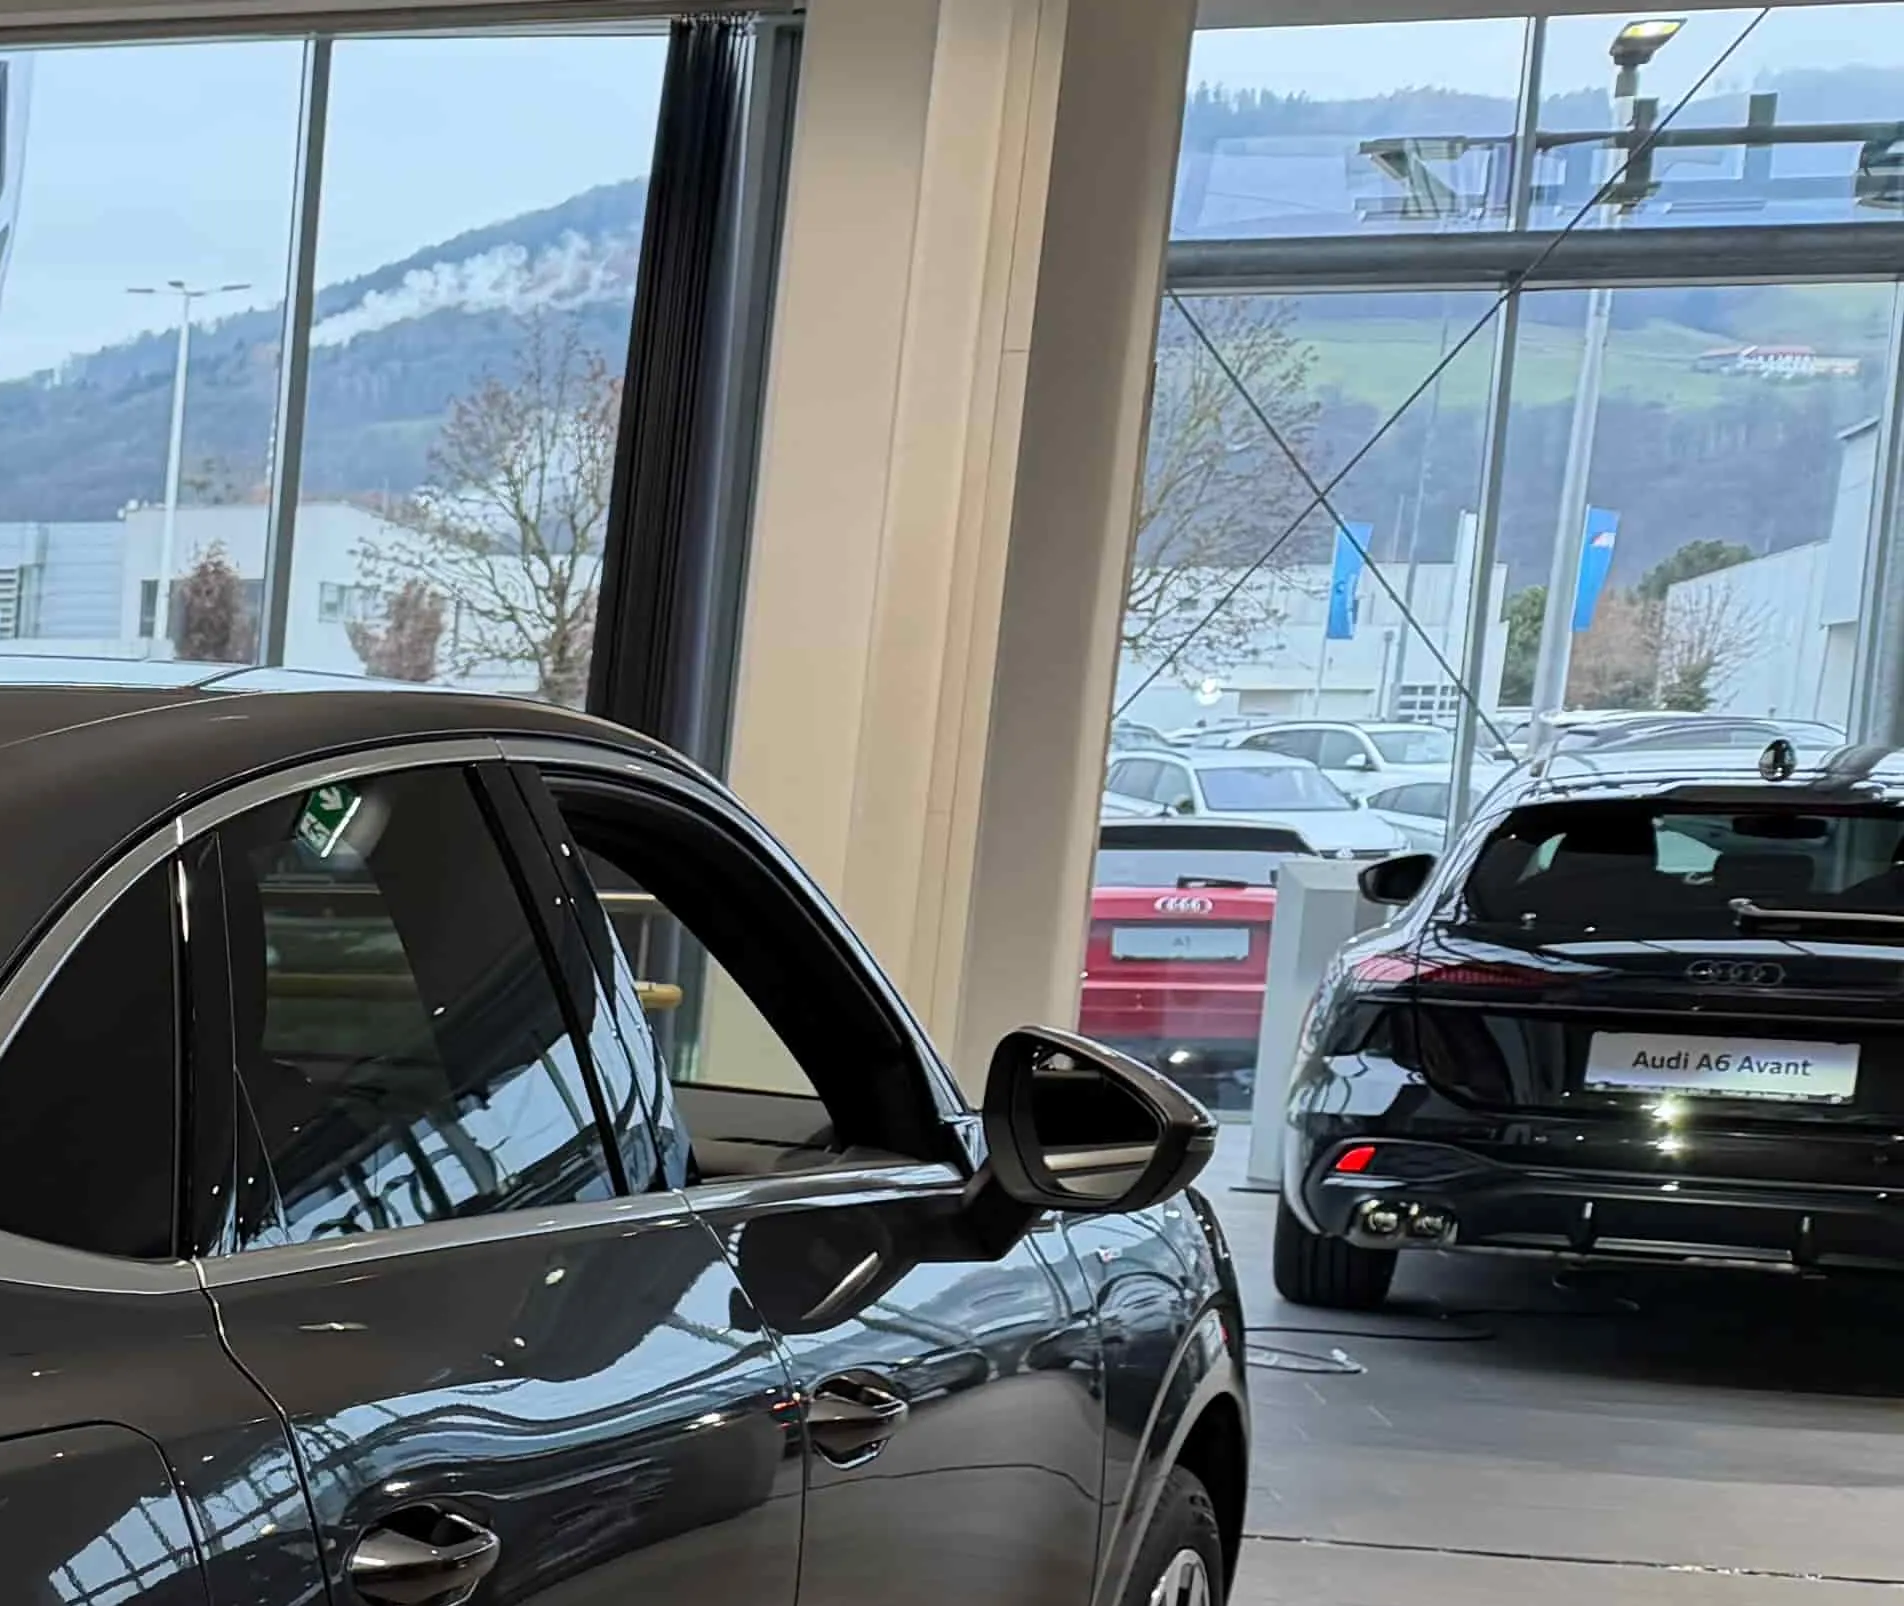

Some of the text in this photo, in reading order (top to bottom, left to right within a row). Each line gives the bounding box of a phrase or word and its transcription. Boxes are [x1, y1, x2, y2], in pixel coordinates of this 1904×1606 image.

[1632, 1051, 1813, 1076] Audi A6 Avant
